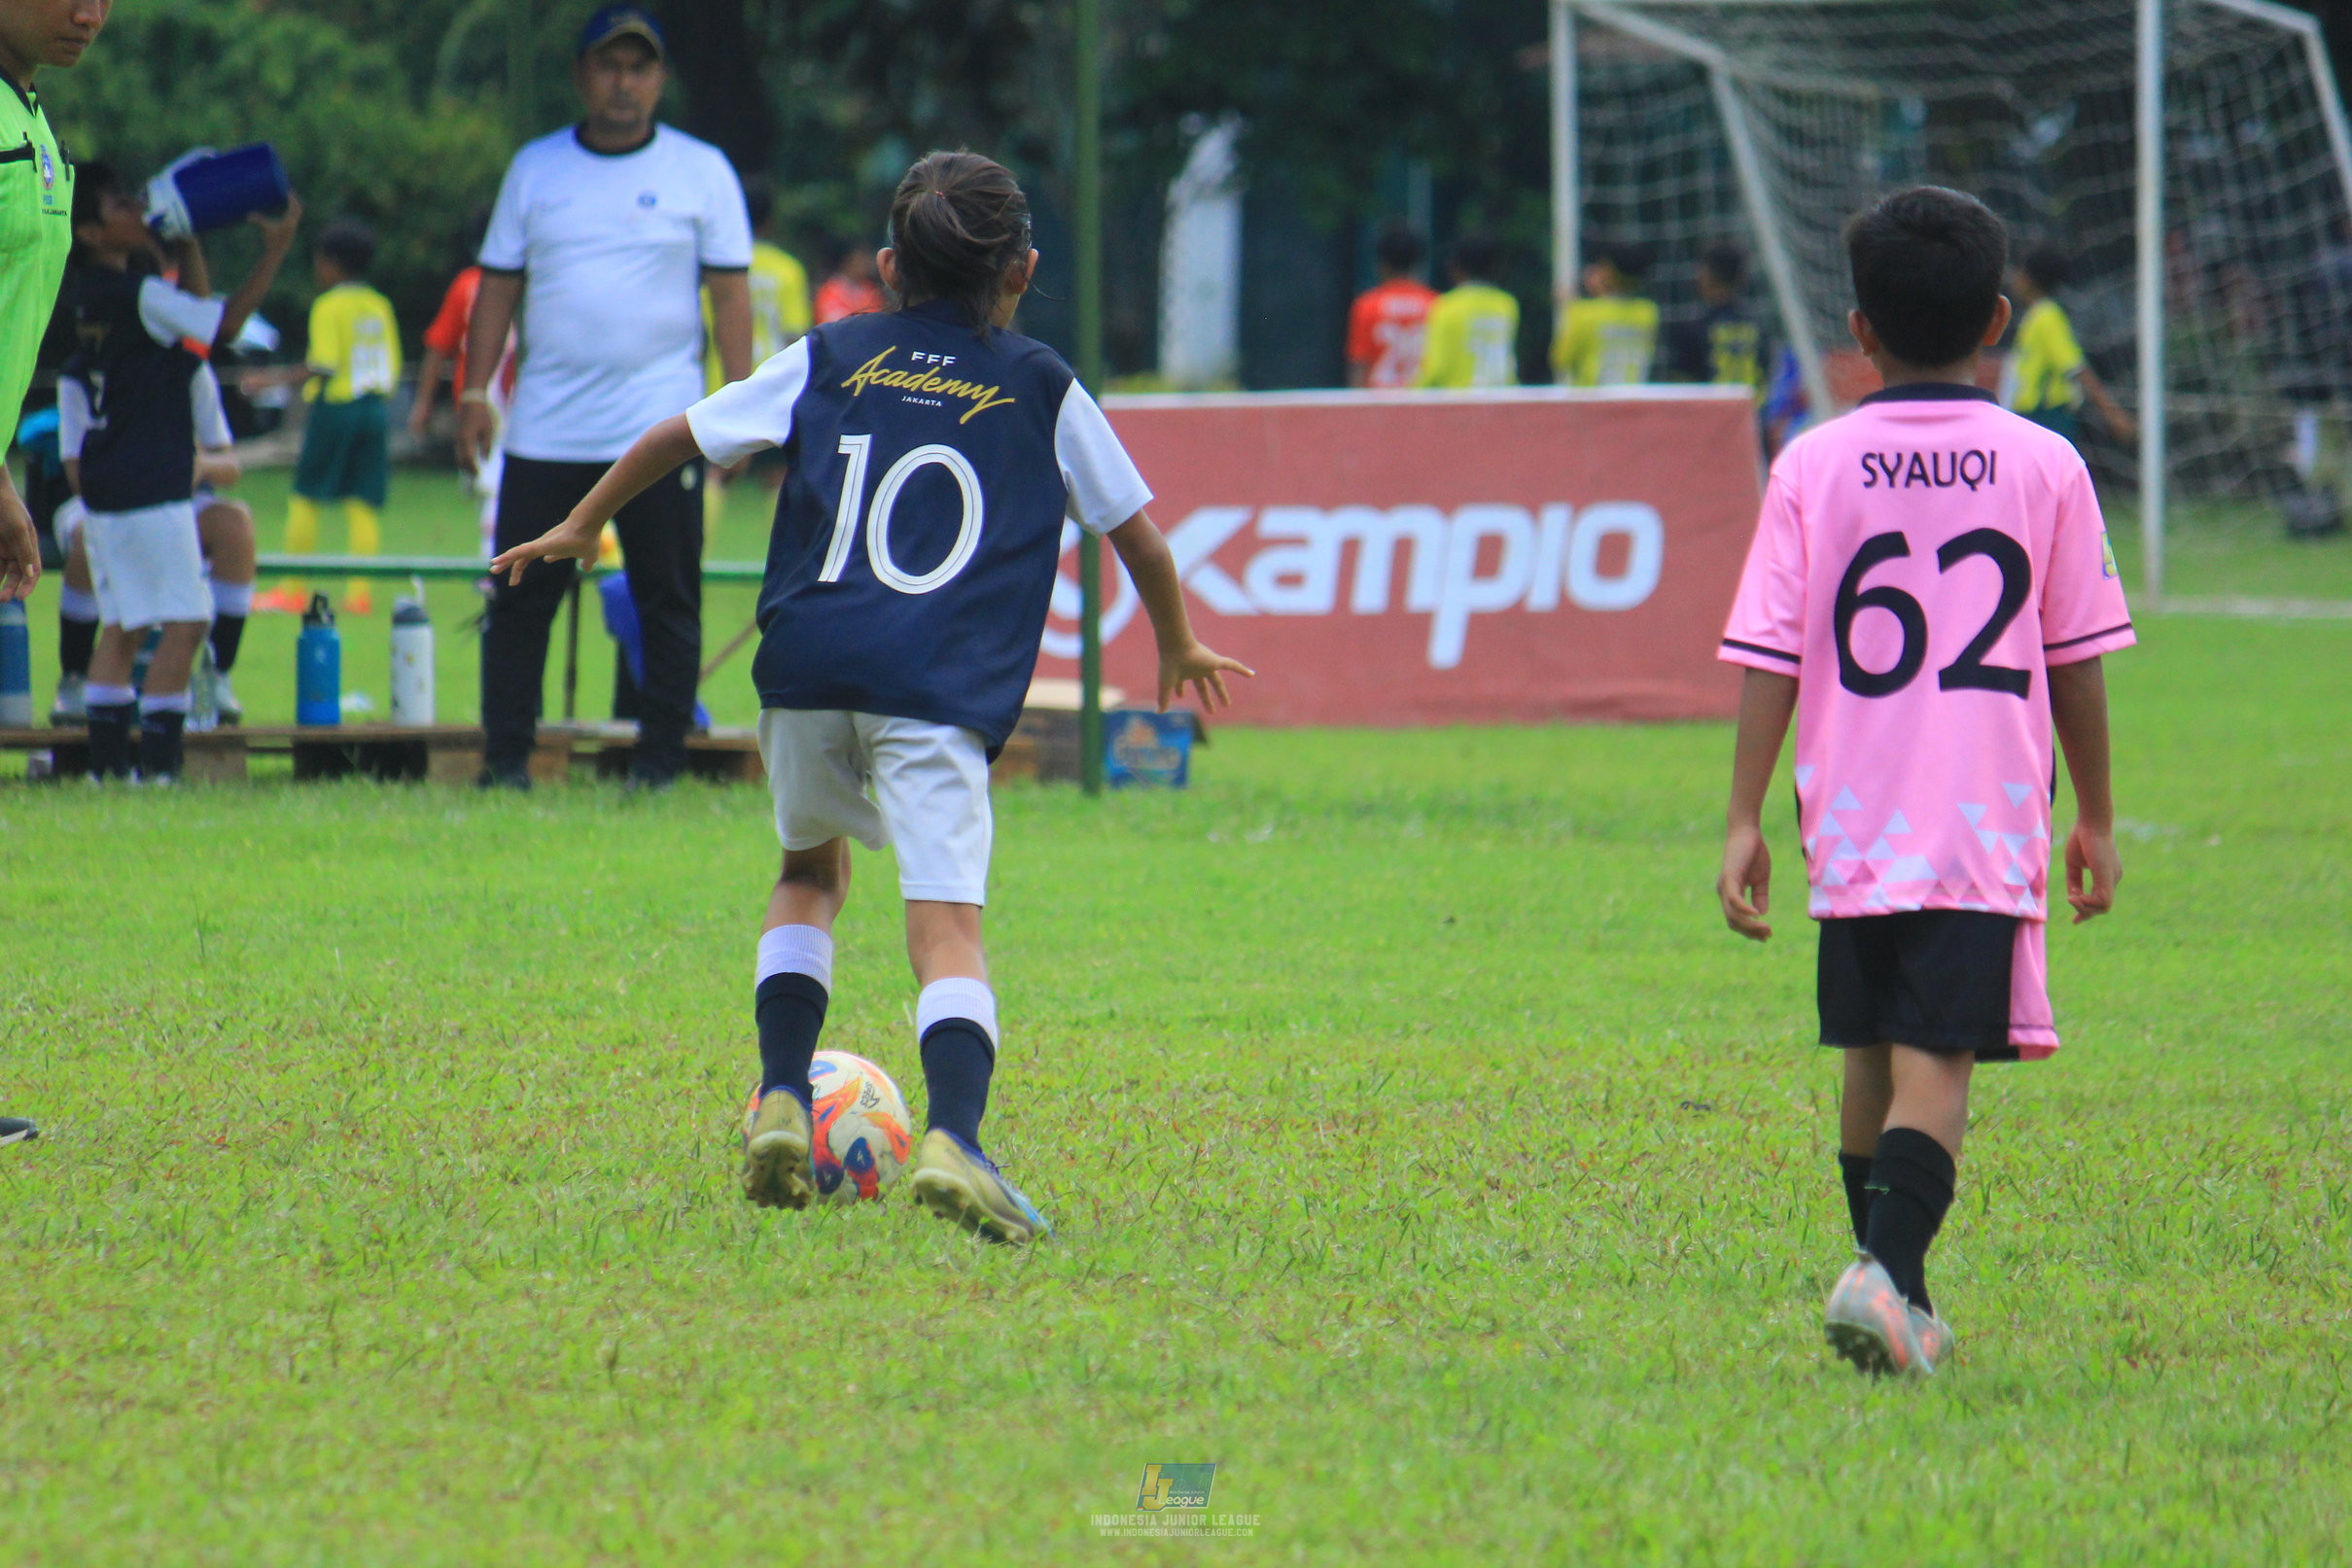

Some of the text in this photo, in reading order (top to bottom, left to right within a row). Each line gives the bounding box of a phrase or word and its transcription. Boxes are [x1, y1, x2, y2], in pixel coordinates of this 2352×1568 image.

[841, 345, 1015, 424] Academy
[911, 351, 957, 366] FFF
[901, 396, 942, 406] JAKARTA
[1861, 449, 1996, 492] SYAUQI
[818, 434, 983, 595] 10
[1834, 528, 2031, 700] 62
